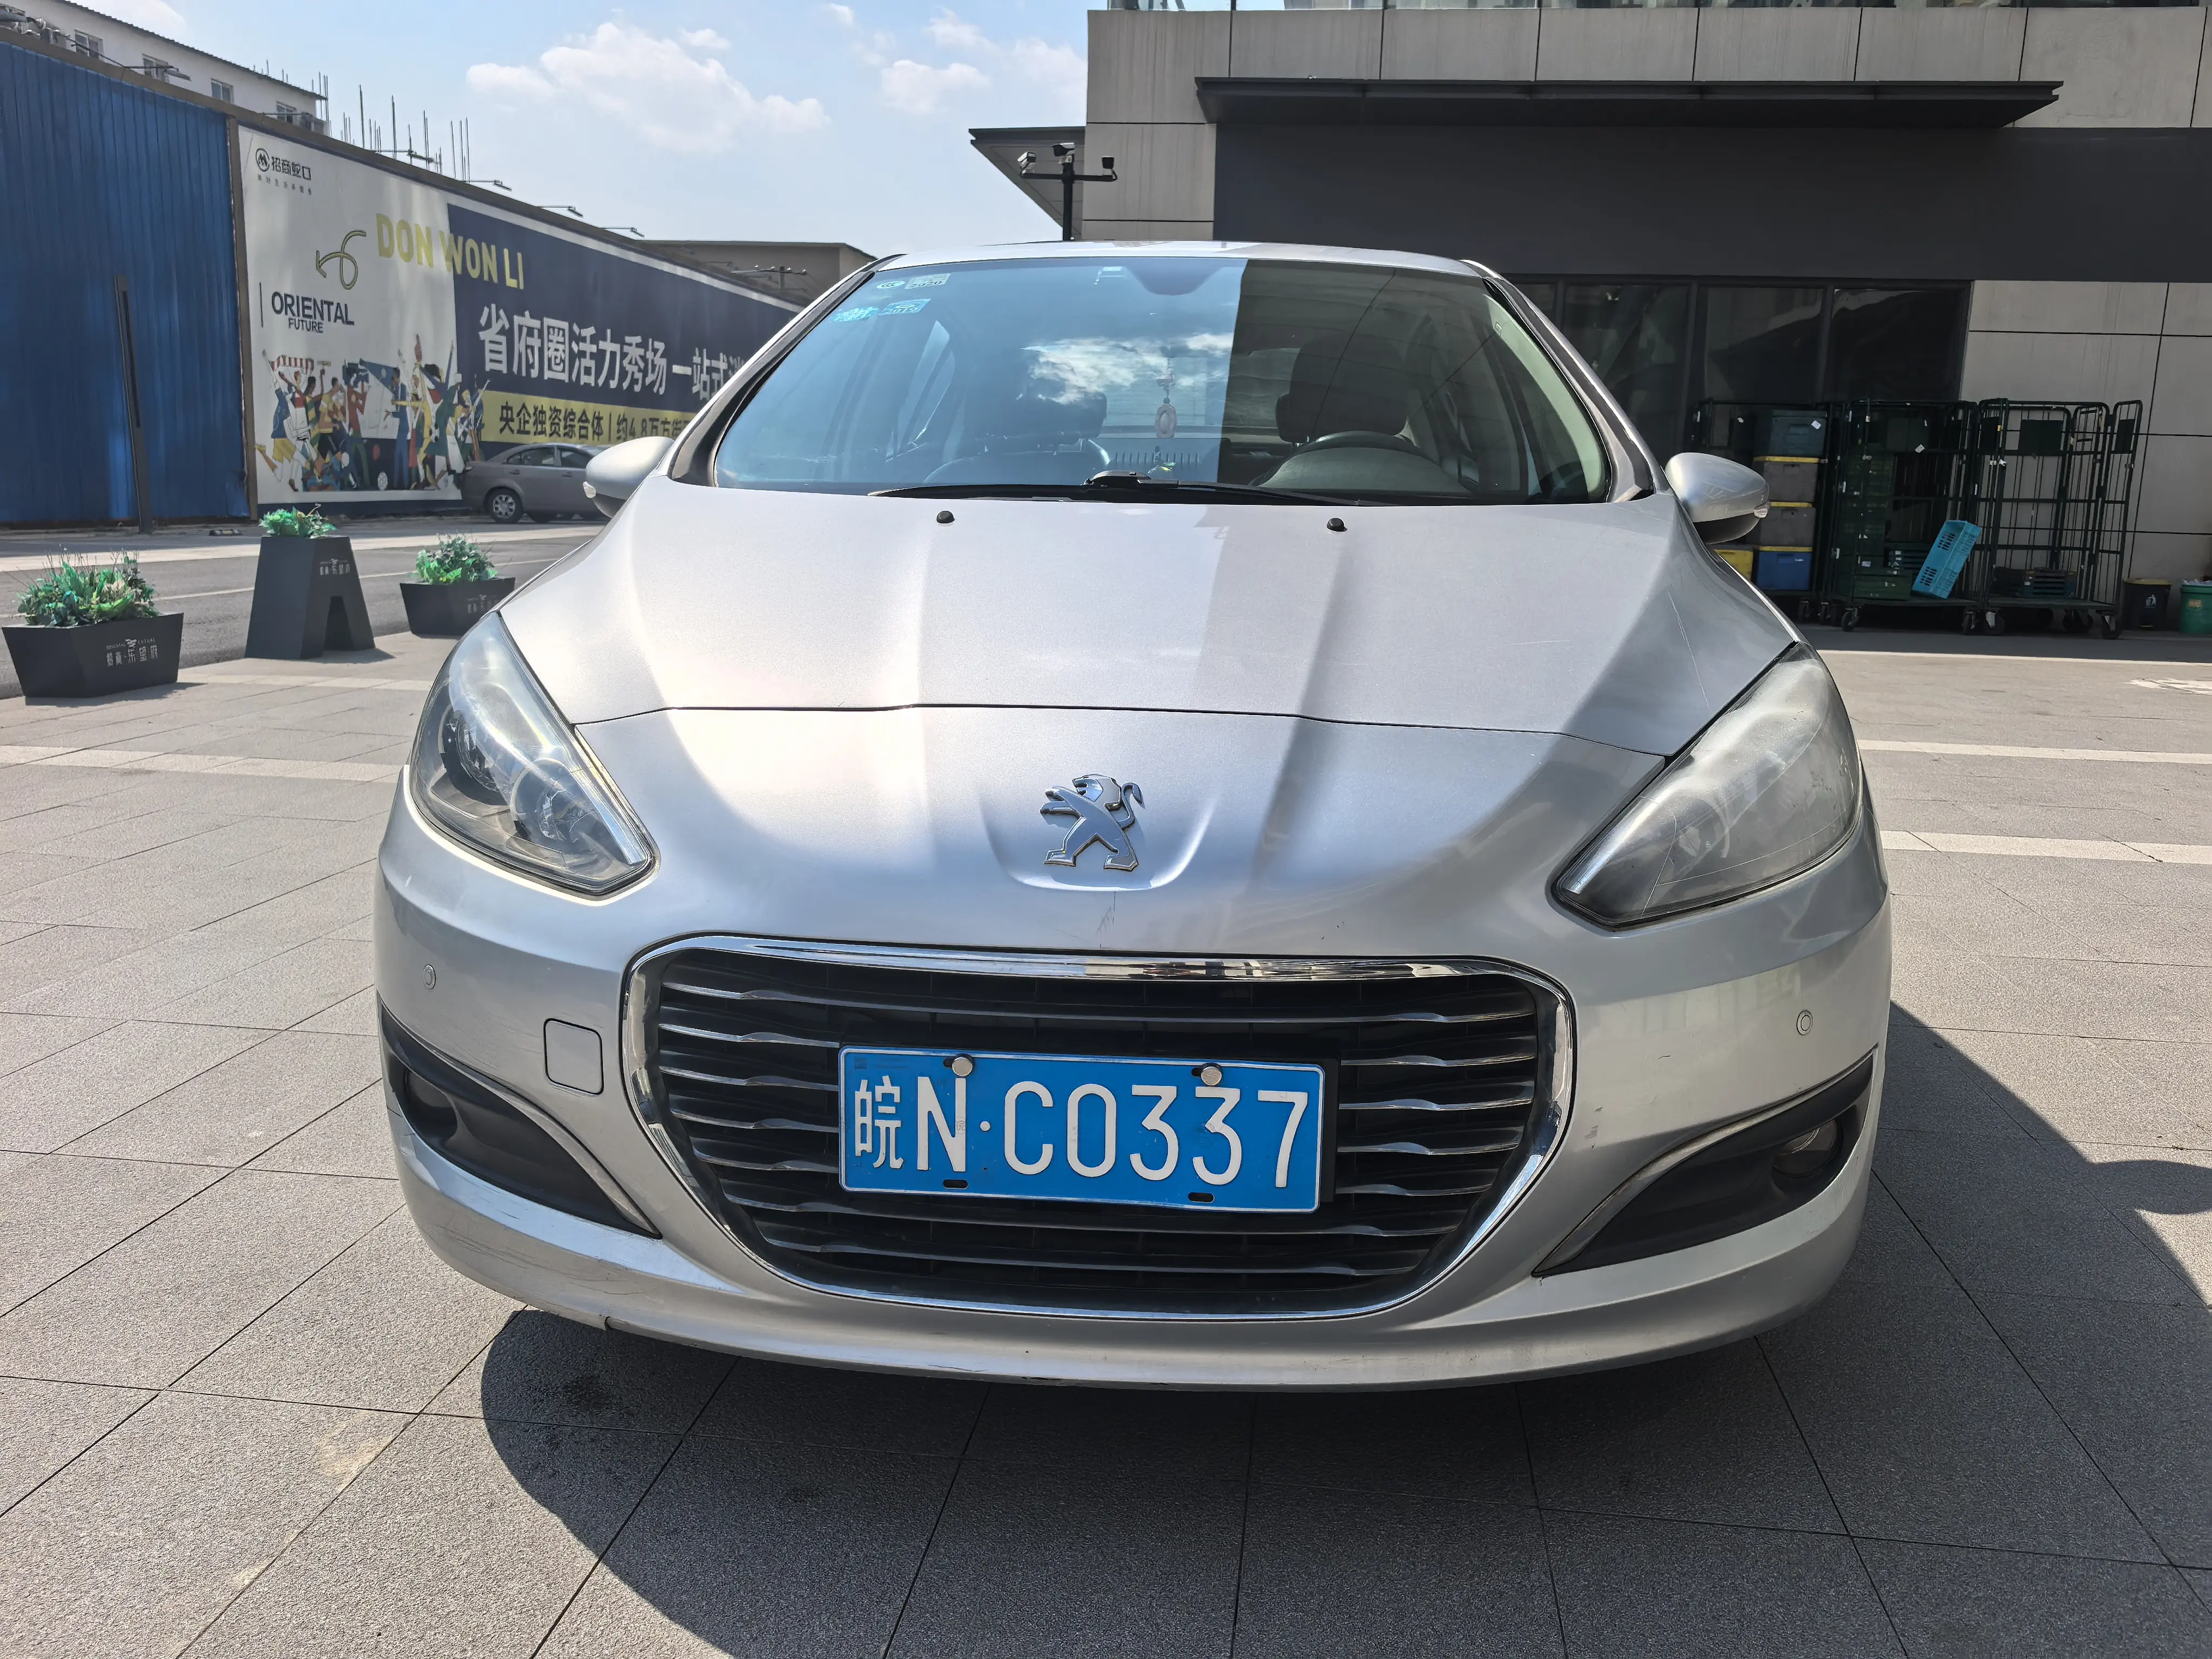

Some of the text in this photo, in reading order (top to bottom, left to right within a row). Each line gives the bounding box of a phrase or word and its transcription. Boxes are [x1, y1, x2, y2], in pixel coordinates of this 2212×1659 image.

[271, 156, 312, 180] 招商蛇口
[375, 213, 524, 290] DON WON LI
[271, 292, 355, 326] ORIENTAL
[288, 317, 324, 333] FUTURE
[854, 1075, 1309, 1189] 皖N·C0337
